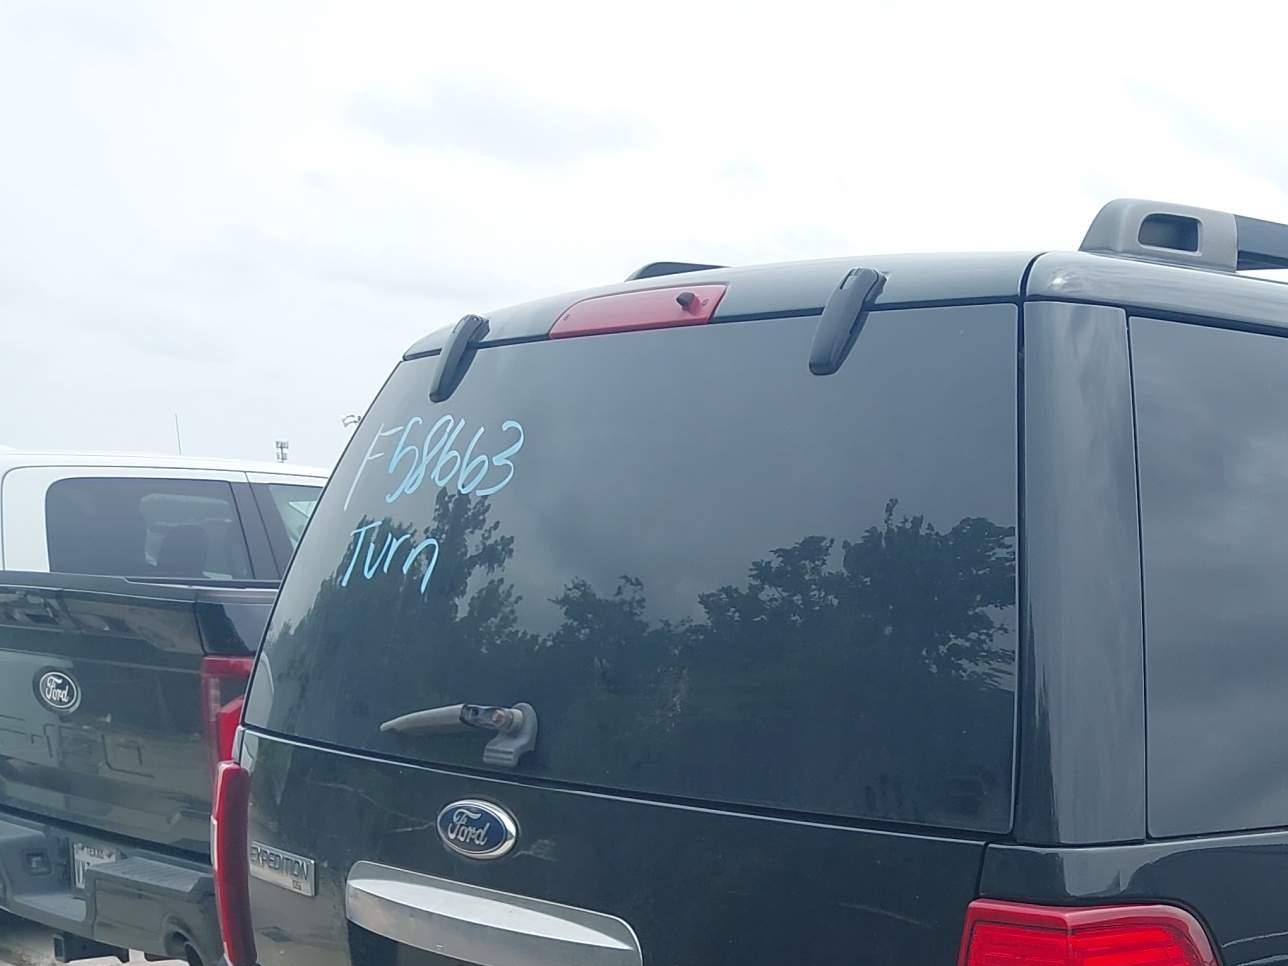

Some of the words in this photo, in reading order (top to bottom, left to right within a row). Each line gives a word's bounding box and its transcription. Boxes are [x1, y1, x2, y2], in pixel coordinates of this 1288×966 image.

[344, 415, 525, 511] F58663
[341, 521, 440, 594] Turn
[45, 675, 70, 703] Ford
[447, 808, 491, 846] Ford
